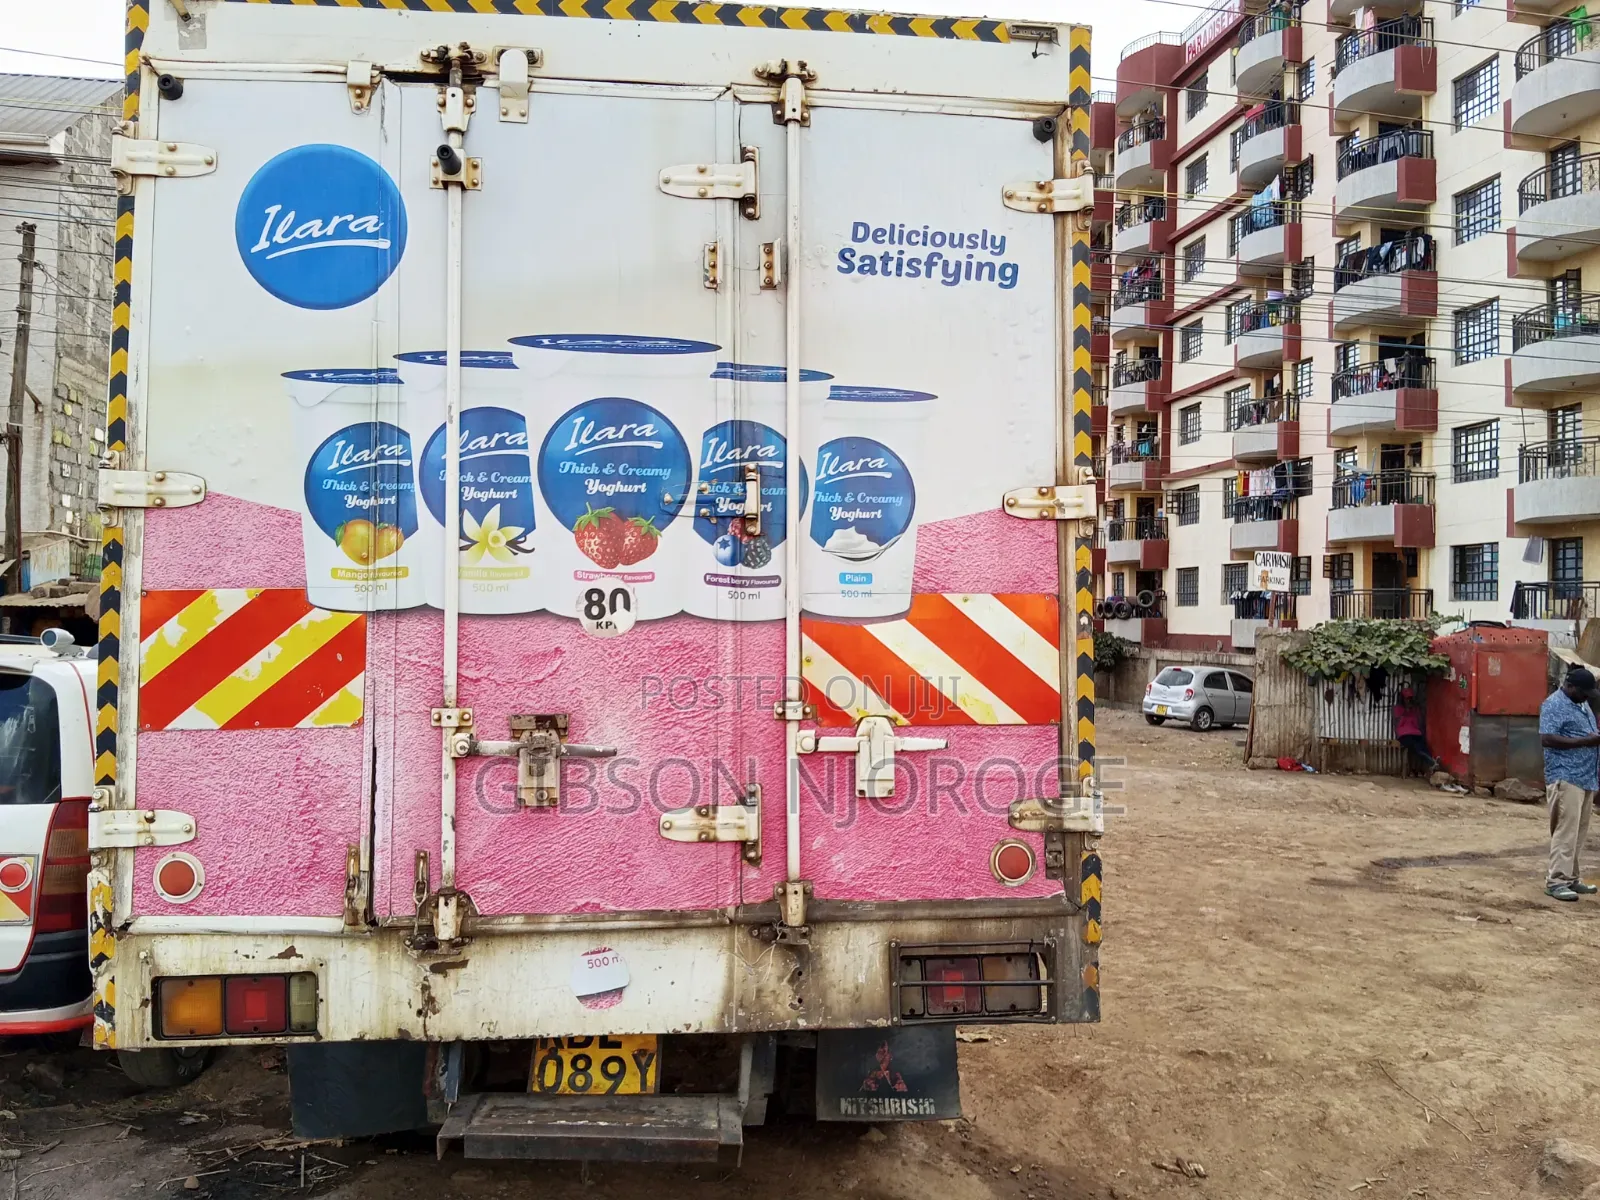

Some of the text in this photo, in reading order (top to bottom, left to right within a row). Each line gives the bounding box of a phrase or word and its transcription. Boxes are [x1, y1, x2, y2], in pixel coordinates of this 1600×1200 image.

[1188, 12, 1225, 60] PARADISE
[251, 204, 384, 253] Ilara
[851, 221, 1006, 256] Deliciously
[837, 247, 1019, 289] Satisfying
[563, 416, 659, 451] Ilara
[442, 429, 528, 459] lara
[327, 440, 407, 470] Ilara
[701, 437, 780, 469] Ilara
[559, 461, 672, 480] Thick & Creamy
[816, 452, 889, 481] Ilara
[477, 471, 488, 483] &
[322, 479, 357, 491] Thick
[360, 481, 370, 492] &
[585, 479, 647, 496] Yoghurt
[733, 482, 744, 494] &
[344, 493, 396, 509] Yoghurt
[461, 486, 518, 502] Yoghurt
[844, 492, 854, 503] &
[857, 492, 904, 507] Creamy
[715, 496, 773, 515] Yogrt
[829, 506, 882, 522] Yoghurt
[337, 570, 368, 580] Mango
[706, 576, 730, 584] Forest
[731, 577, 750, 587] berry
[845, 574, 866, 582] Plain
[353, 584, 373, 593] 500
[472, 583, 509, 593] 500 ml
[728, 590, 760, 599] 500 ml
[841, 590, 872, 598] 500 ml
[584, 588, 631, 620] 80
[587, 956, 609, 969] 500
[538, 1053, 656, 1095] 089Y
